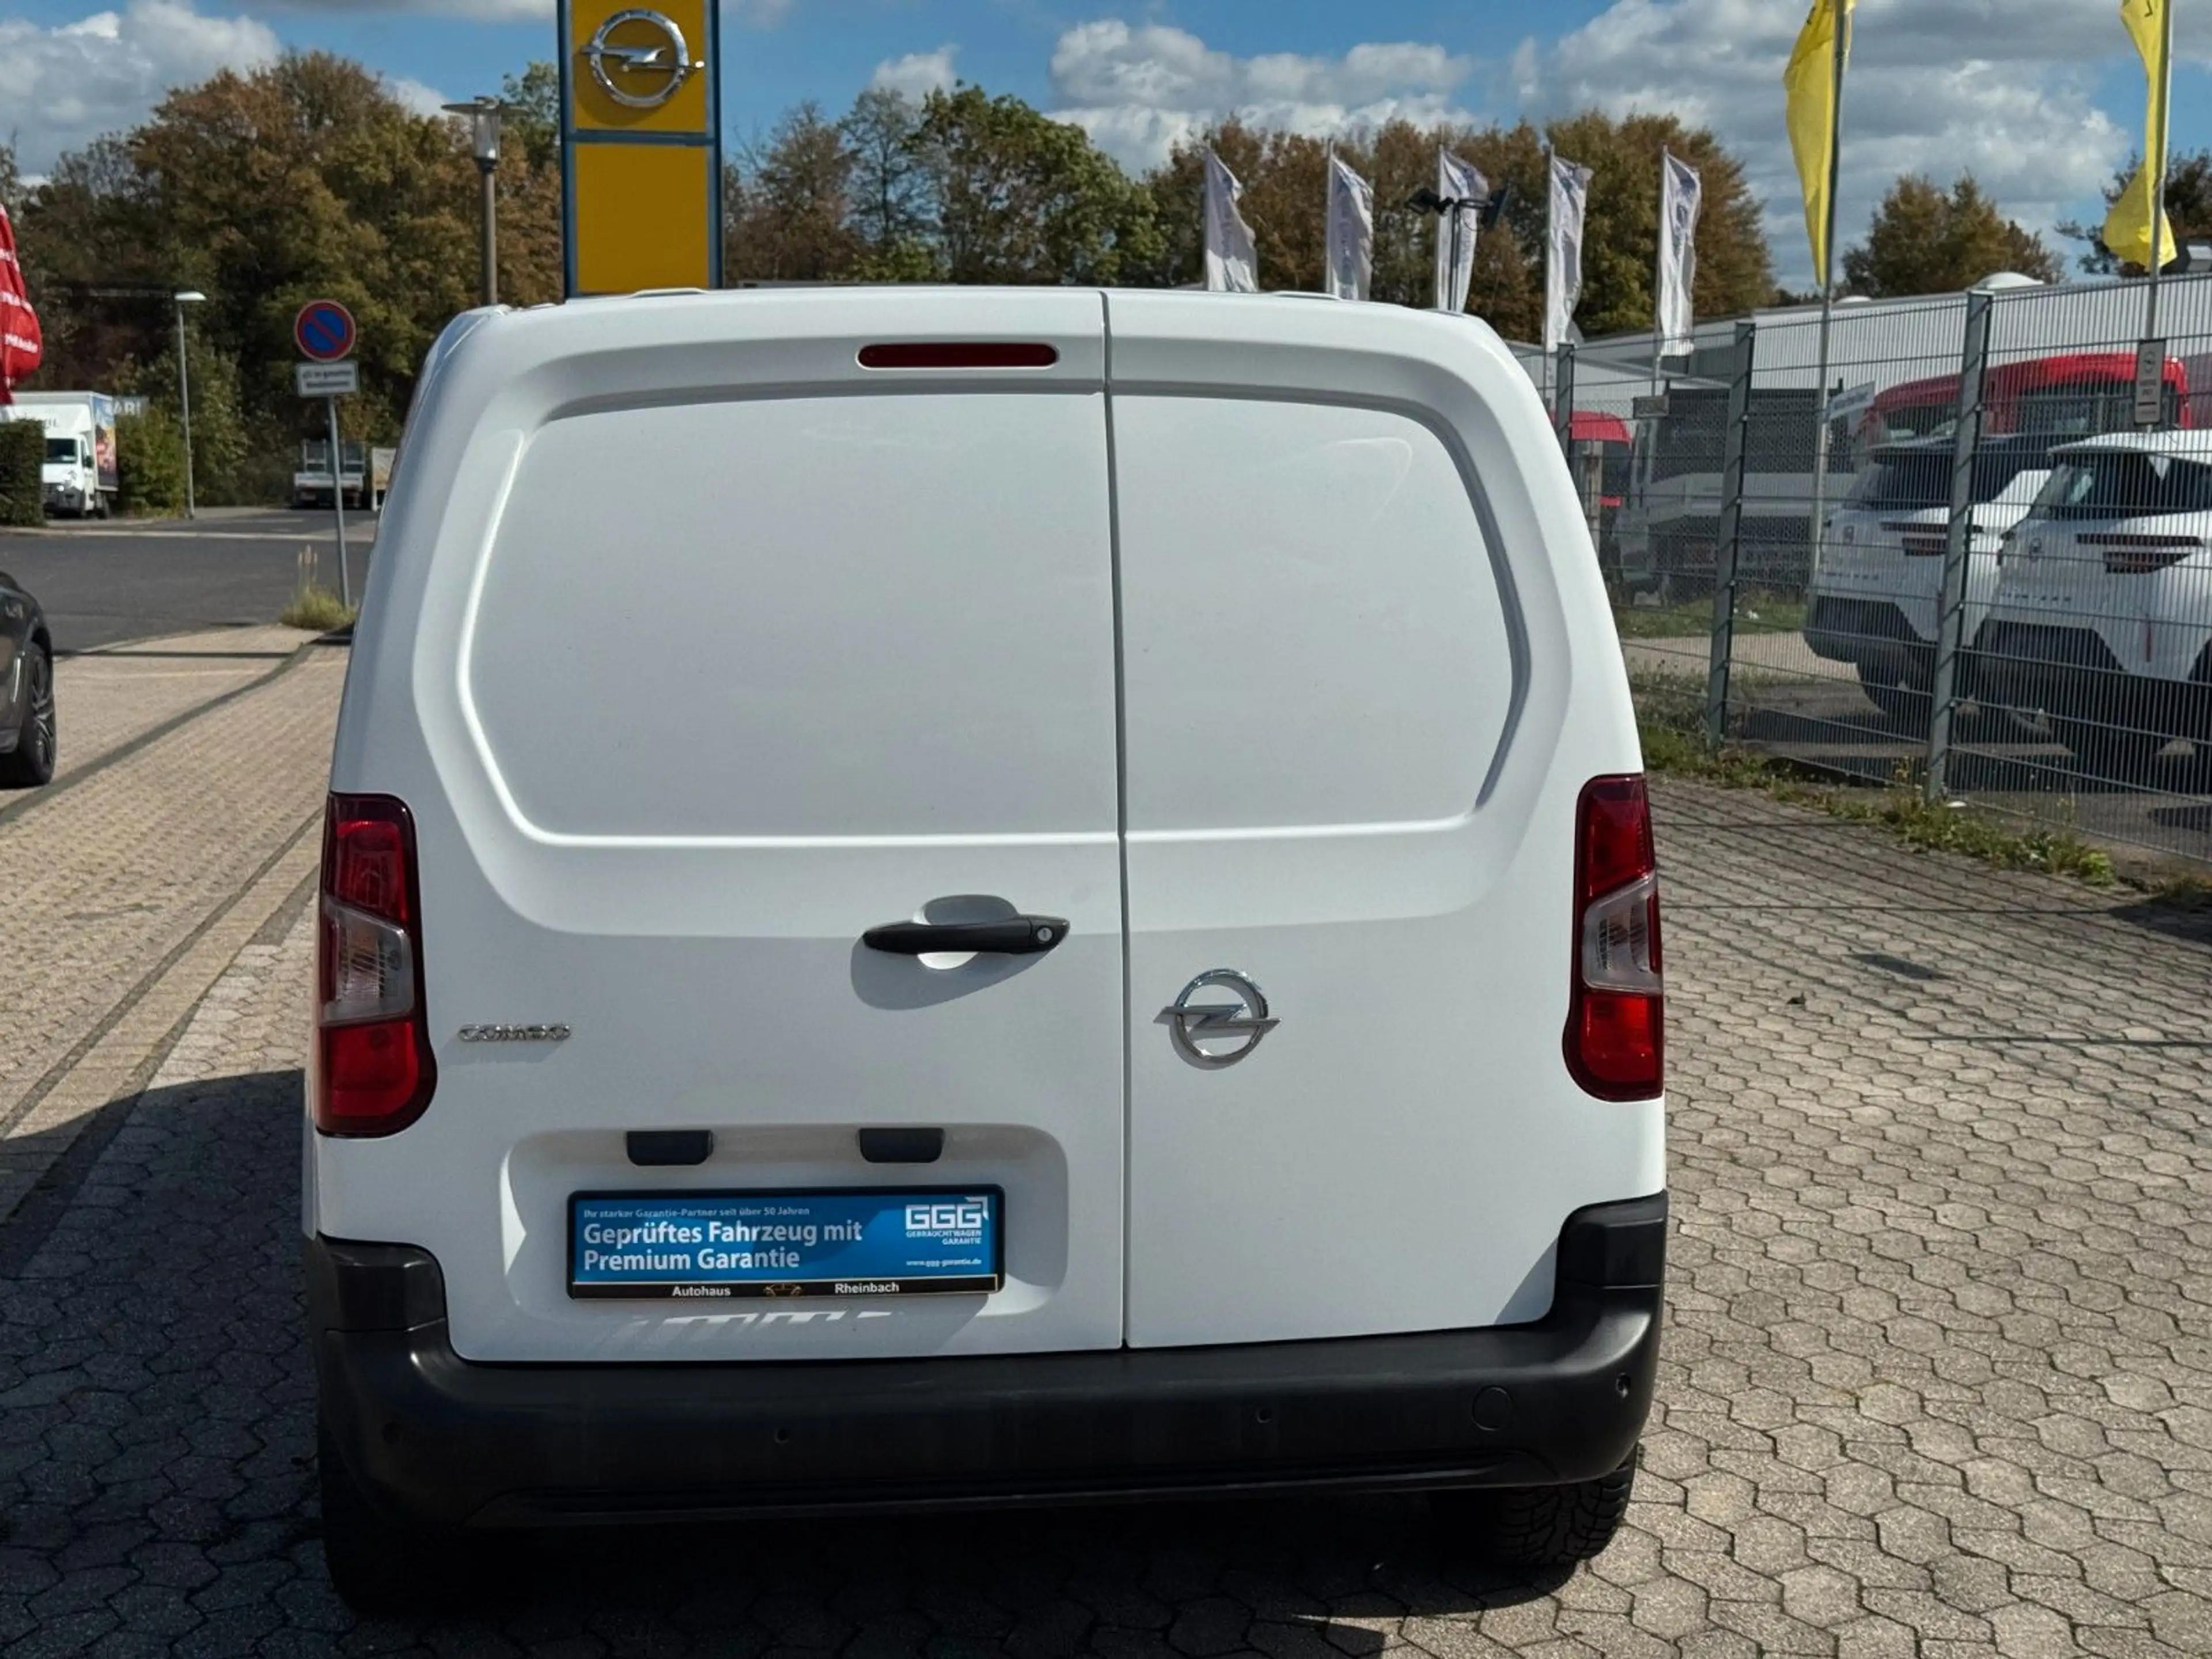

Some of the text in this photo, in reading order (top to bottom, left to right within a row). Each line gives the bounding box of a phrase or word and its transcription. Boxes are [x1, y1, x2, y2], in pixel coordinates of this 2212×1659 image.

[459, 1022, 571, 1041] COMBO
[584, 1207, 809, 1218] Ihr starker Garantie-Partner seit über 50 Jahren
[906, 1204, 982, 1230] GGG
[584, 1219, 863, 1249] Geprüftes Fahrzeug mit
[906, 1230, 982, 1238] GEBRAUCHTWAGEN
[942, 1237, 982, 1245] GARANTIE
[584, 1246, 800, 1271] Premium Garantie
[672, 1282, 900, 1297] Autohaus Rheinbach
